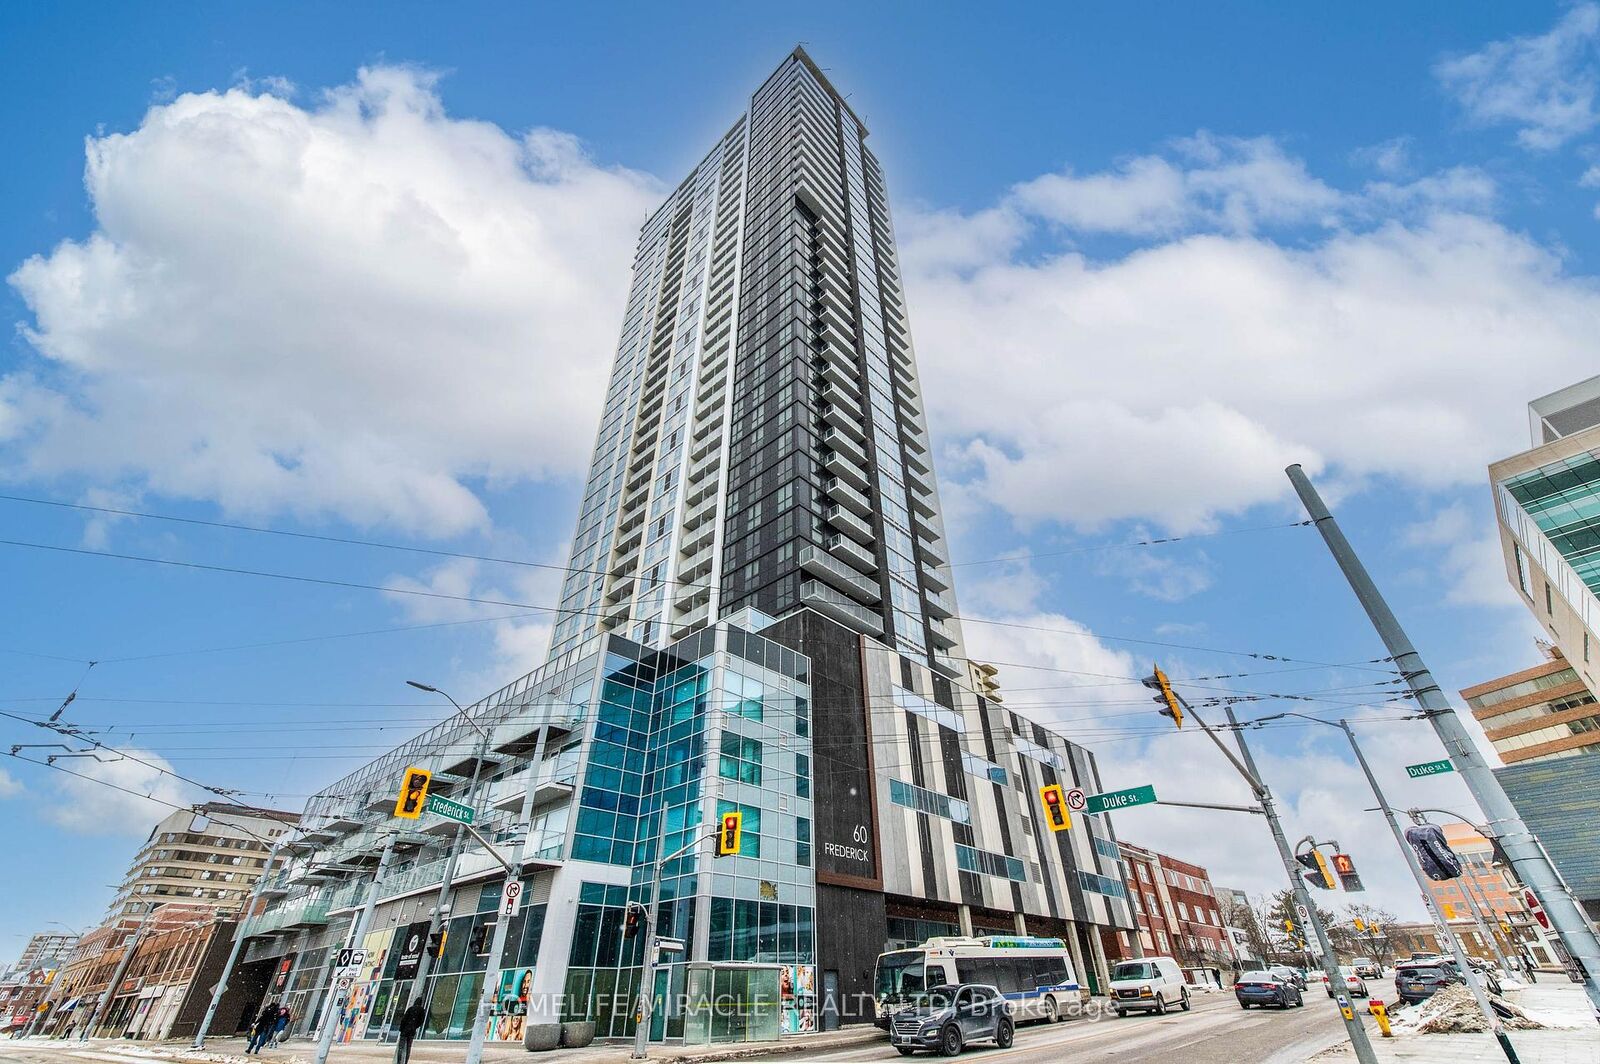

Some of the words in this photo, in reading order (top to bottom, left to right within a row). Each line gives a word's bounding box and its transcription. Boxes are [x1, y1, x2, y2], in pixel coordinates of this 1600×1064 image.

[1409, 765, 1436, 777] Duke
[432, 799, 464, 819] Frederick
[1102, 794, 1128, 809] Duke
[853, 824, 867, 844] 60
[824, 842, 869, 862] FREDERICK
